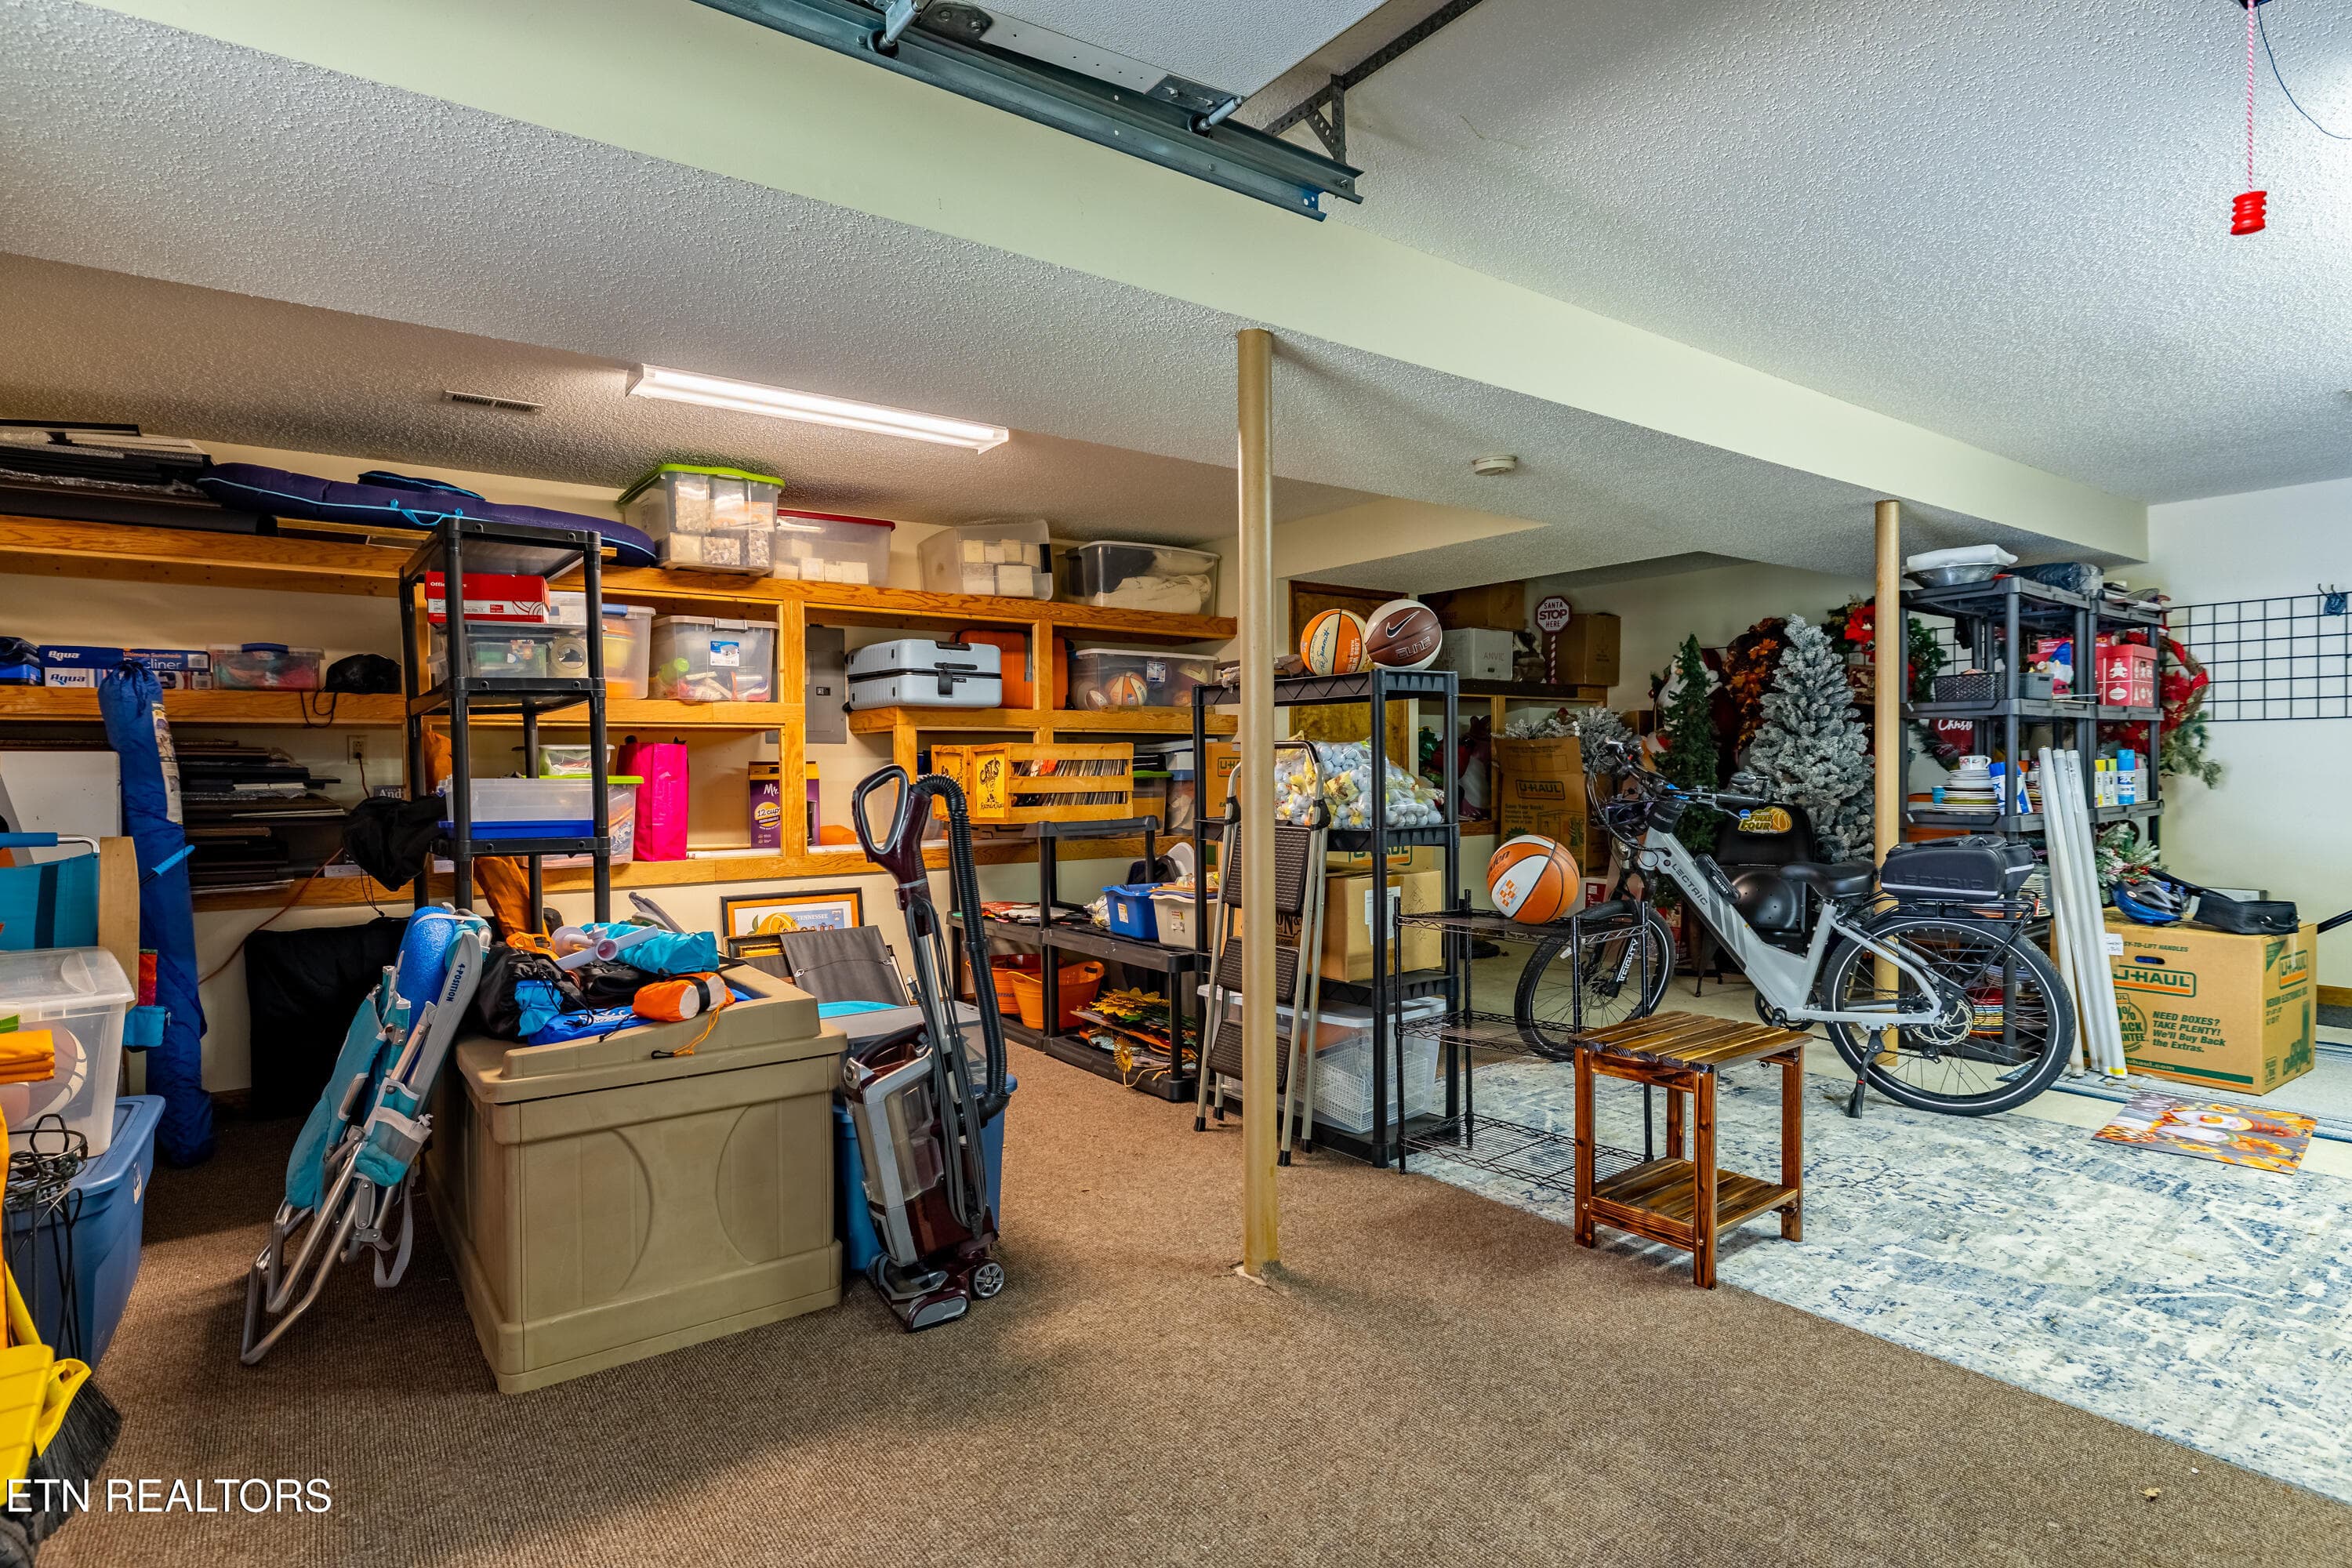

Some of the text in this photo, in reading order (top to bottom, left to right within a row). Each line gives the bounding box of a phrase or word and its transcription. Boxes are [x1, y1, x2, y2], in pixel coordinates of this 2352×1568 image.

[1539, 609, 1567, 620] STOP
[1396, 636, 1432, 659] ELITE
[48, 651, 80, 662] Aqua
[50, 673, 86, 685] Aqua
[379, 788, 402, 799] And
[764, 783, 779, 797] Mr.
[1519, 782, 1562, 793] U-HAUL
[757, 807, 780, 817] 12 cup
[1738, 821, 1771, 831] FOUR
[1671, 863, 1708, 906] LECTRIC
[1894, 873, 1984, 888] LECTRIC
[446, 964, 466, 1002] 4-POSITION
[2152, 1011, 2221, 1026] NEED BOXES?
[2120, 1022, 2143, 1032] ACK
[2153, 1020, 2221, 1036] TAKE PLENTY!
[2153, 1029, 2227, 1047] We'll Buy Back
[2152, 1039, 2205, 1053] the Extras.
